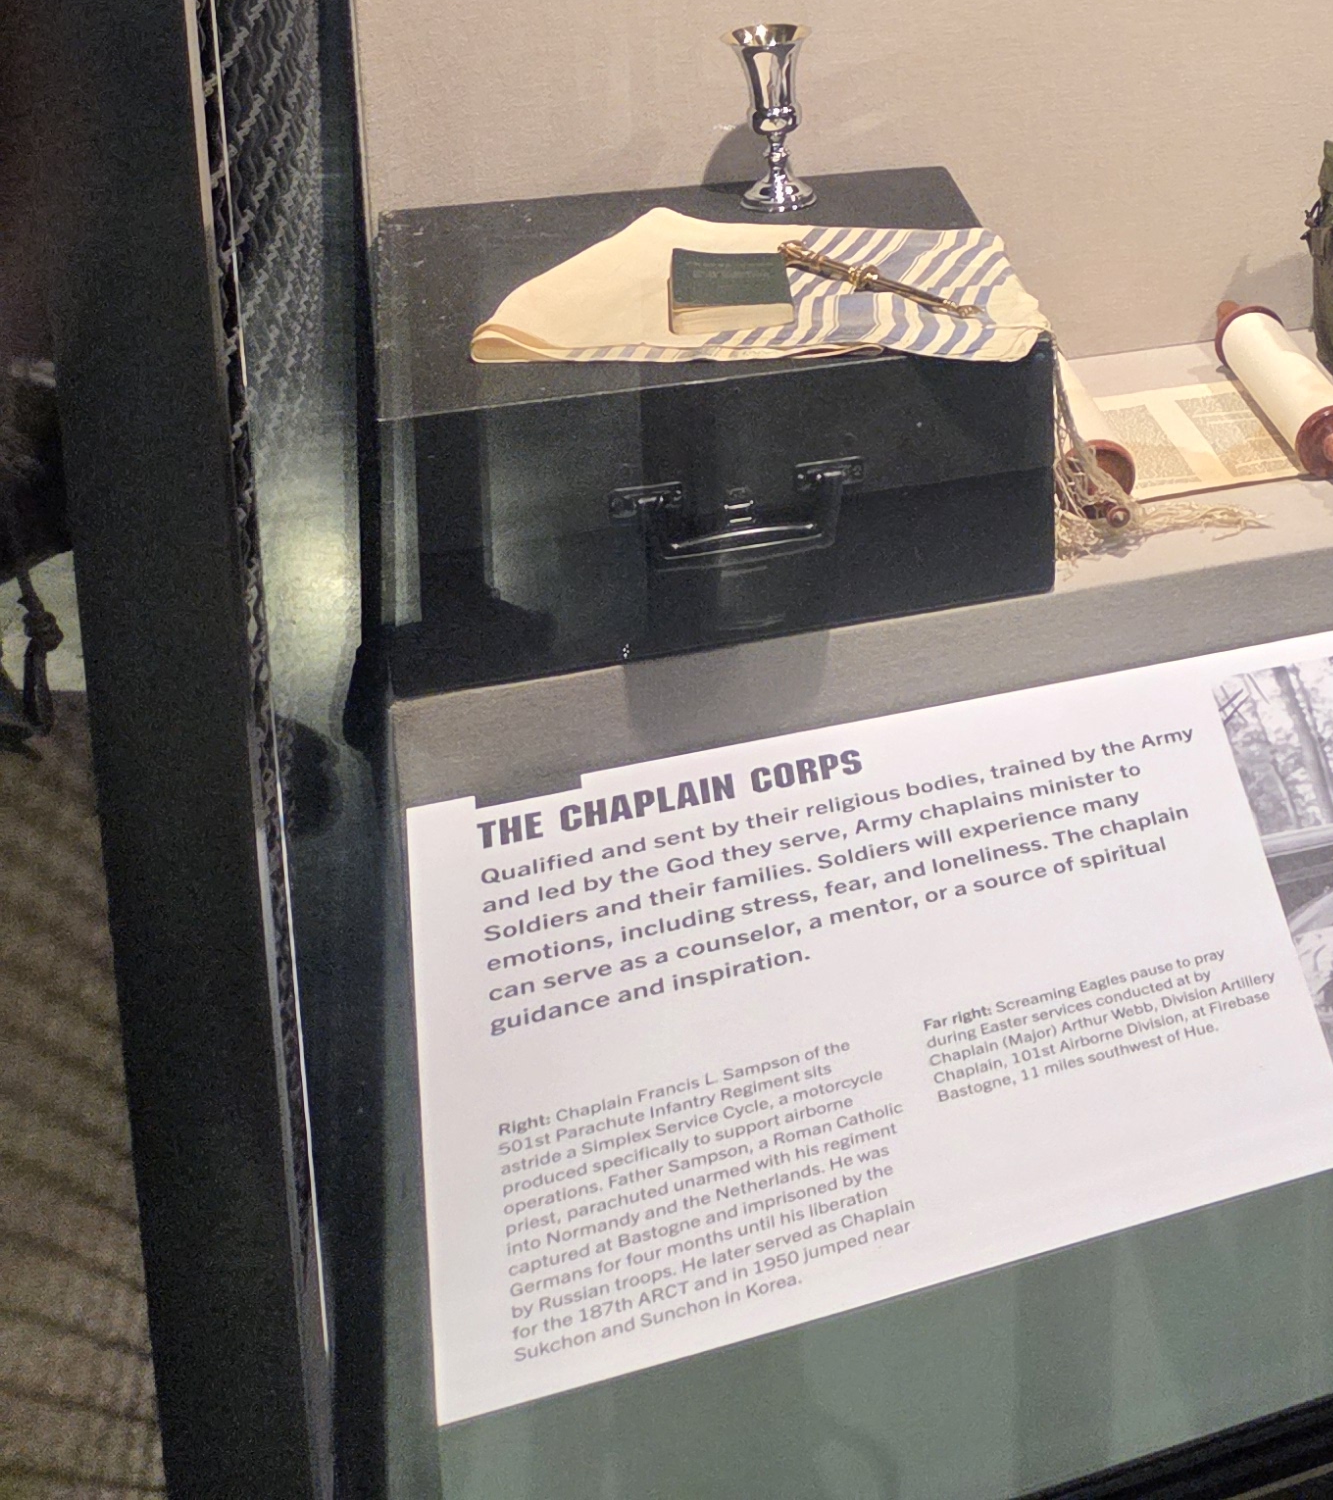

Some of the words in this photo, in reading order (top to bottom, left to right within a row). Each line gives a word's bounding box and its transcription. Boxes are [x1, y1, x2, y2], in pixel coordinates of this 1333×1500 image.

[477, 811, 543, 849] THE
[560, 773, 735, 832] CHAPLAIN
[750, 749, 862, 793] CORPS
[481, 847, 593, 884] Qualified
[601, 836, 646, 860] and
[654, 825, 706, 849] sent
[712, 821, 739, 837] by
[745, 807, 799, 829] their
[806, 788, 900, 818] religious
[906, 773, 985, 797] bodies,
[990, 751, 1066, 779] trained
[1070, 748, 1095, 764] by
[1101, 741, 1135, 756] the
[1141, 728, 1193, 749] Army
[482, 889, 529, 913] and
[538, 879, 575, 902] led
[583, 875, 613, 893] by
[619, 866, 659, 884] the
[666, 850, 714, 873] God
[721, 841, 772, 862] they
[779, 828, 847, 850] serve,
[855, 812, 913, 835] Army
[919, 790, 1024, 820] chaplains
[1029, 770, 1114, 798] minister
[1119, 765, 1141, 778] to
[484, 910, 588, 942] Soldiers
[596, 894, 642, 918] and
[648, 882, 706, 906] their
[712, 863, 811, 893] families.
[817, 841, 910, 869] Soldiers
[915, 827, 952, 849] will
[959, 805, 1077, 839] experience
[1082, 791, 1139, 814] many
[487, 935, 613, 971] emotions,
[621, 906, 735, 943] including
[741, 890, 818, 915] stress,
[824, 876, 877, 897] fear,
[884, 861, 926, 884] and
[932, 840, 1048, 874] loneliness.
[1051, 829, 1094, 846] The
[1100, 807, 1189, 836] chaplain
[489, 981, 535, 1001] can
[543, 964, 612, 989] serve
[619, 956, 647, 973] as
[655, 951, 668, 964] a
[676, 921, 801, 959] counselor,
[809, 917, 822, 930] a
[829, 895, 918, 925] mentor,
[925, 888, 947, 903] or
[954, 884, 967, 897] a
[973, 866, 1047, 892] source
[1053, 856, 1074, 874] of
[1080, 836, 1166, 869] spiritual
[491, 995, 610, 1036] guidance
[618, 977, 665, 1003] and
[672, 950, 810, 991] inspiration.
[922, 1017, 948, 1032] Far
[952, 1005, 993, 1025] right:
[995, 986, 1078, 1013] Screaming
[1078, 974, 1128, 993] Eagles
[1129, 962, 1174, 983] pause
[1175, 958, 1191, 969] to
[1193, 949, 1225, 968] pray
[925, 1028, 978, 1049] during
[979, 1015, 1028, 1036] Easter
[1031, 1000, 1093, 1023] services
[1095, 977, 1174, 1007] conducted
[1176, 974, 1192, 987] at
[1193, 970, 1211, 983] by
[928, 1040, 999, 1067] Chaplain
[1002, 1024, 1057, 1050] (Major)
[1061, 1013, 1108, 1034] Arthur
[1110, 1001, 1158, 1021] Webb,
[1160, 987, 1218, 1009] Division
[1220, 972, 1275, 995] Artillery
[933, 1058, 1008, 1084] Chaplain,
[1011, 1043, 1057, 1065] 101st
[1059, 1028, 1124, 1053] Airborne
[1126, 1013, 1188, 1035] Division,
[1191, 1005, 1207, 1019] at
[1208, 991, 1271, 1015] Firebase
[498, 1114, 551, 1136] Right:
[556, 1094, 632, 1122] Chaplain
[637, 1078, 700, 1102] Francis
[723, 1054, 800, 1081] Sampson
[804, 1046, 820, 1061] of
[823, 1042, 850, 1056] the
[498, 1133, 551, 1155] 501st
[556, 1112, 645, 1142] Parachute
[650, 1093, 716, 1119] Infantry
[720, 1070, 800, 1101] Regiment
[804, 1065, 832, 1080] sits
[937, 1075, 1017, 1103] Bastogne,
[1020, 1066, 1040, 1082] 11
[1044, 1056, 1085, 1076] miles
[1087, 1034, 1164, 1064] southwest
[1166, 1029, 1181, 1044] of
[1183, 1023, 1219, 1039] Hue.
[501, 1151, 561, 1175] astride
[566, 1148, 576, 1159] a
[581, 1129, 651, 1155] Simplex
[655, 1113, 718, 1137] Service
[722, 1099, 774, 1119] Cycle,
[778, 1095, 788, 1106] a
[793, 1071, 883, 1102] motorcycle
[503, 1162, 587, 1197] produced
[593, 1139, 689, 1173] specifically
[693, 1134, 711, 1147] to
[715, 1114, 781, 1141] support
[784, 1098, 853, 1124] airborne
